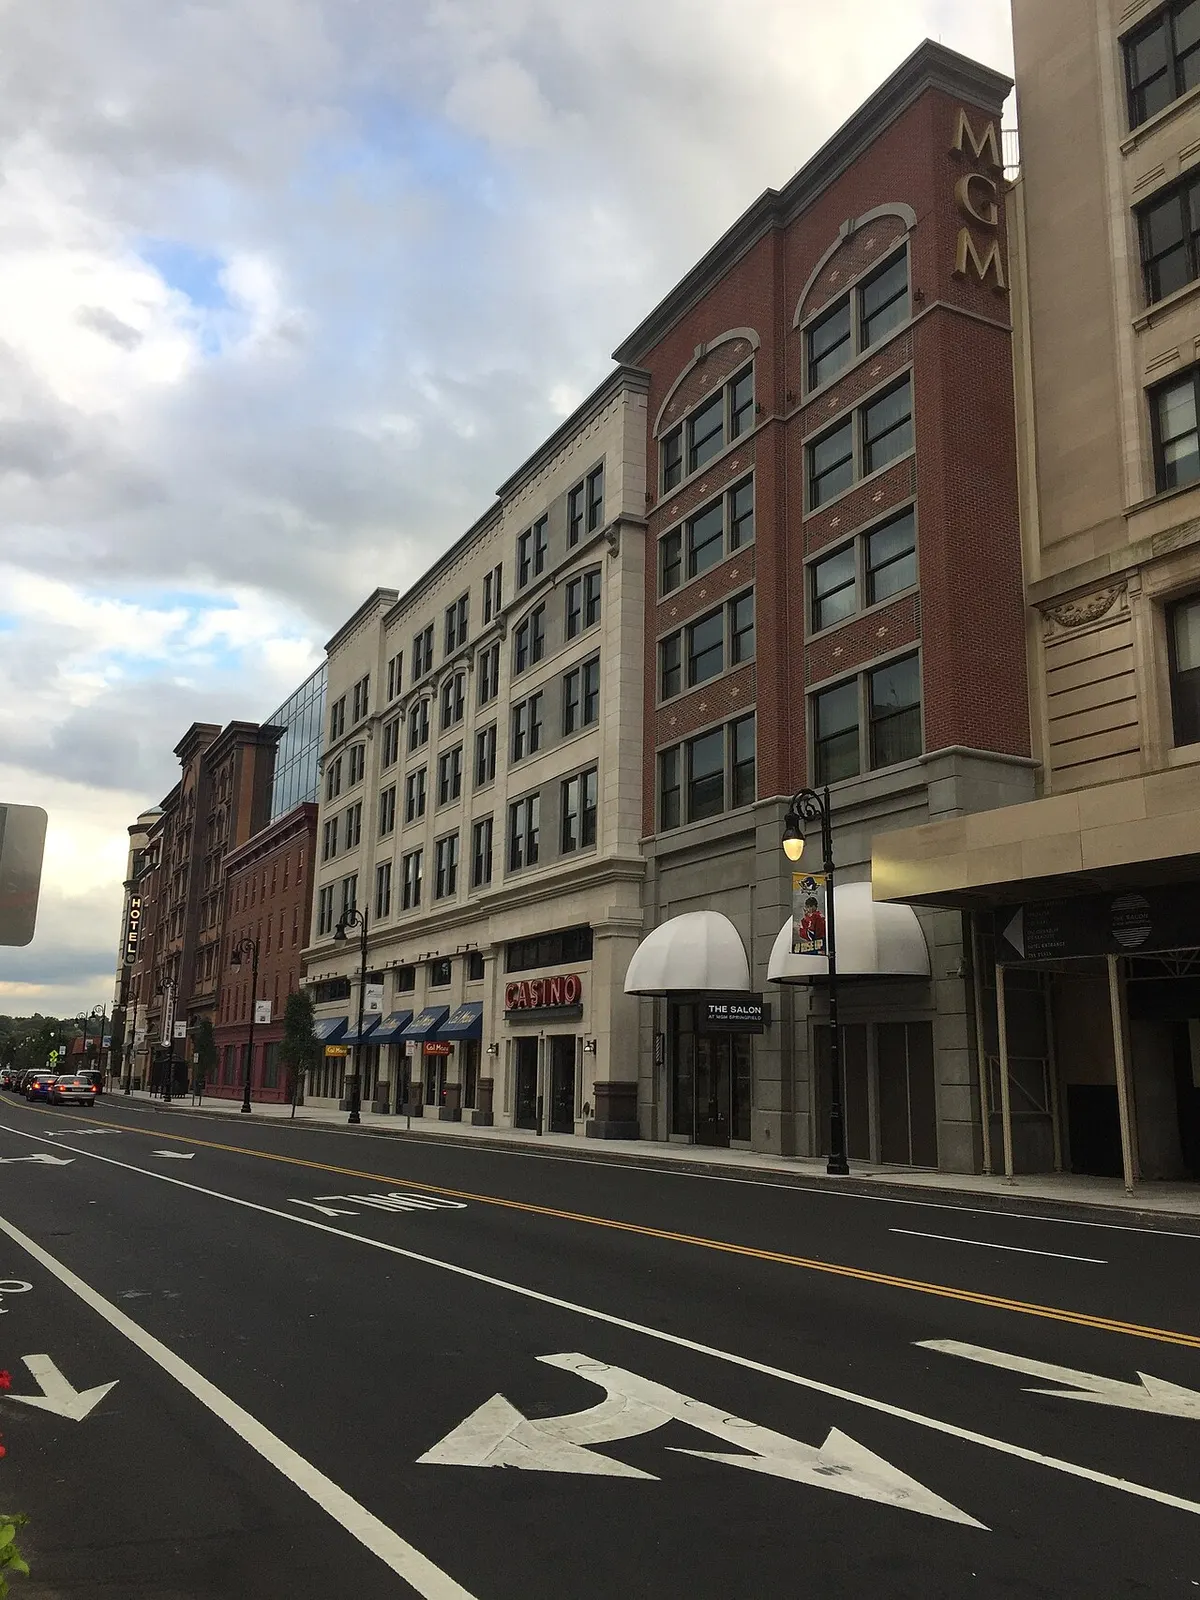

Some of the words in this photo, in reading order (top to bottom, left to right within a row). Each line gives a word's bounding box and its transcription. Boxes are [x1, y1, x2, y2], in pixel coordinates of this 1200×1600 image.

[951, 107, 1006, 289] MGM
[127, 898, 141, 954] HOTEL
[505, 974, 582, 1009] CASINO
[708, 1005, 728, 1013] THE
[730, 1006, 761, 1014] SALON
